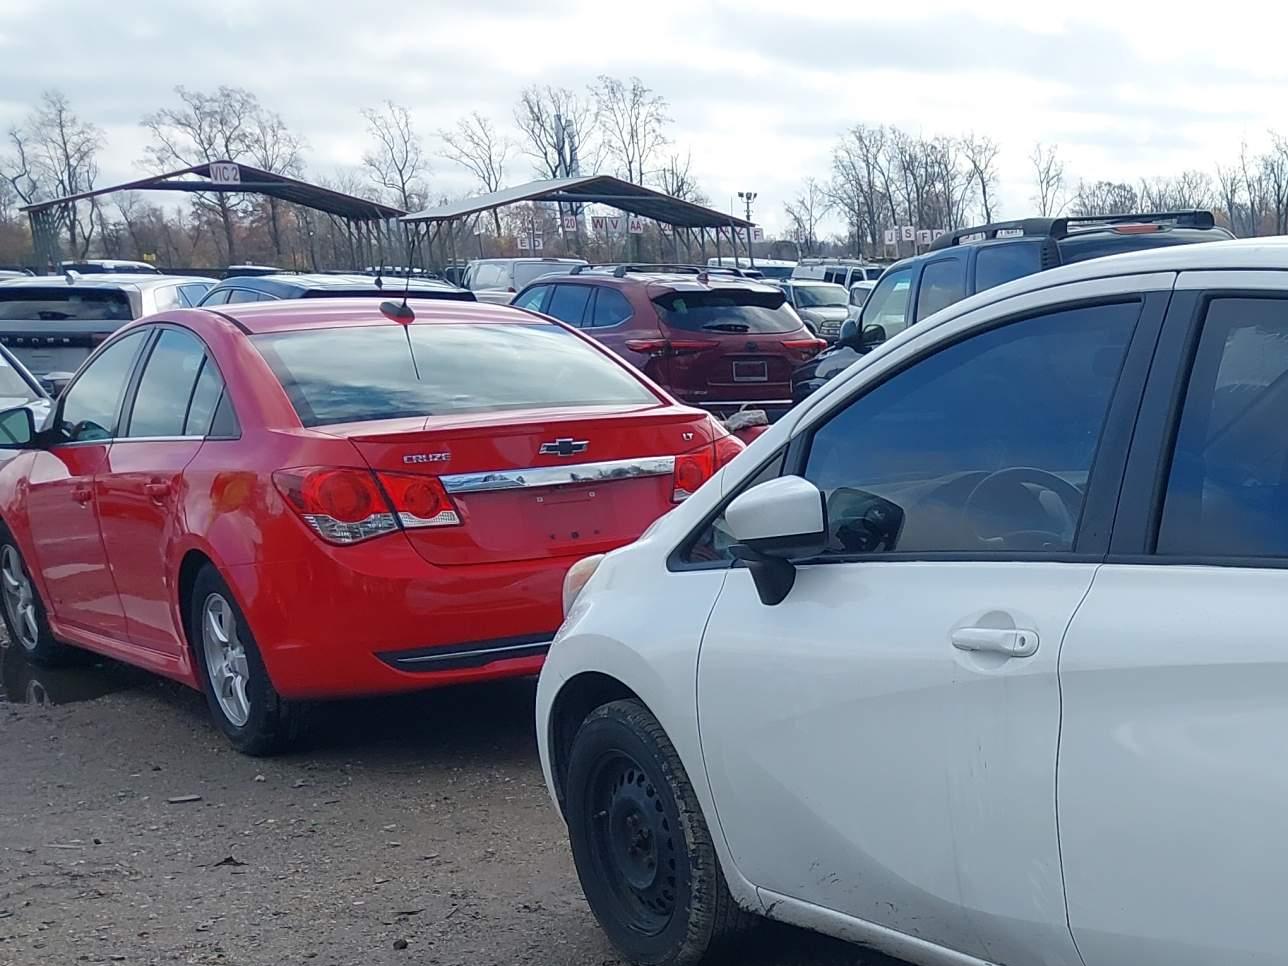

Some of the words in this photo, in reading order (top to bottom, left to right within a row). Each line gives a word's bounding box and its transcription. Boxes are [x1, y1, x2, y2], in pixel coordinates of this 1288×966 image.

[211, 166, 230, 181] VIC
[232, 166, 239, 181] 2
[564, 218, 576, 228] 20
[592, 218, 604, 229] W
[610, 219, 618, 229] V
[630, 220, 641, 230] AA
[905, 229, 912, 238] S
[682, 432, 694, 441] LT
[403, 452, 452, 464] CRUZE
